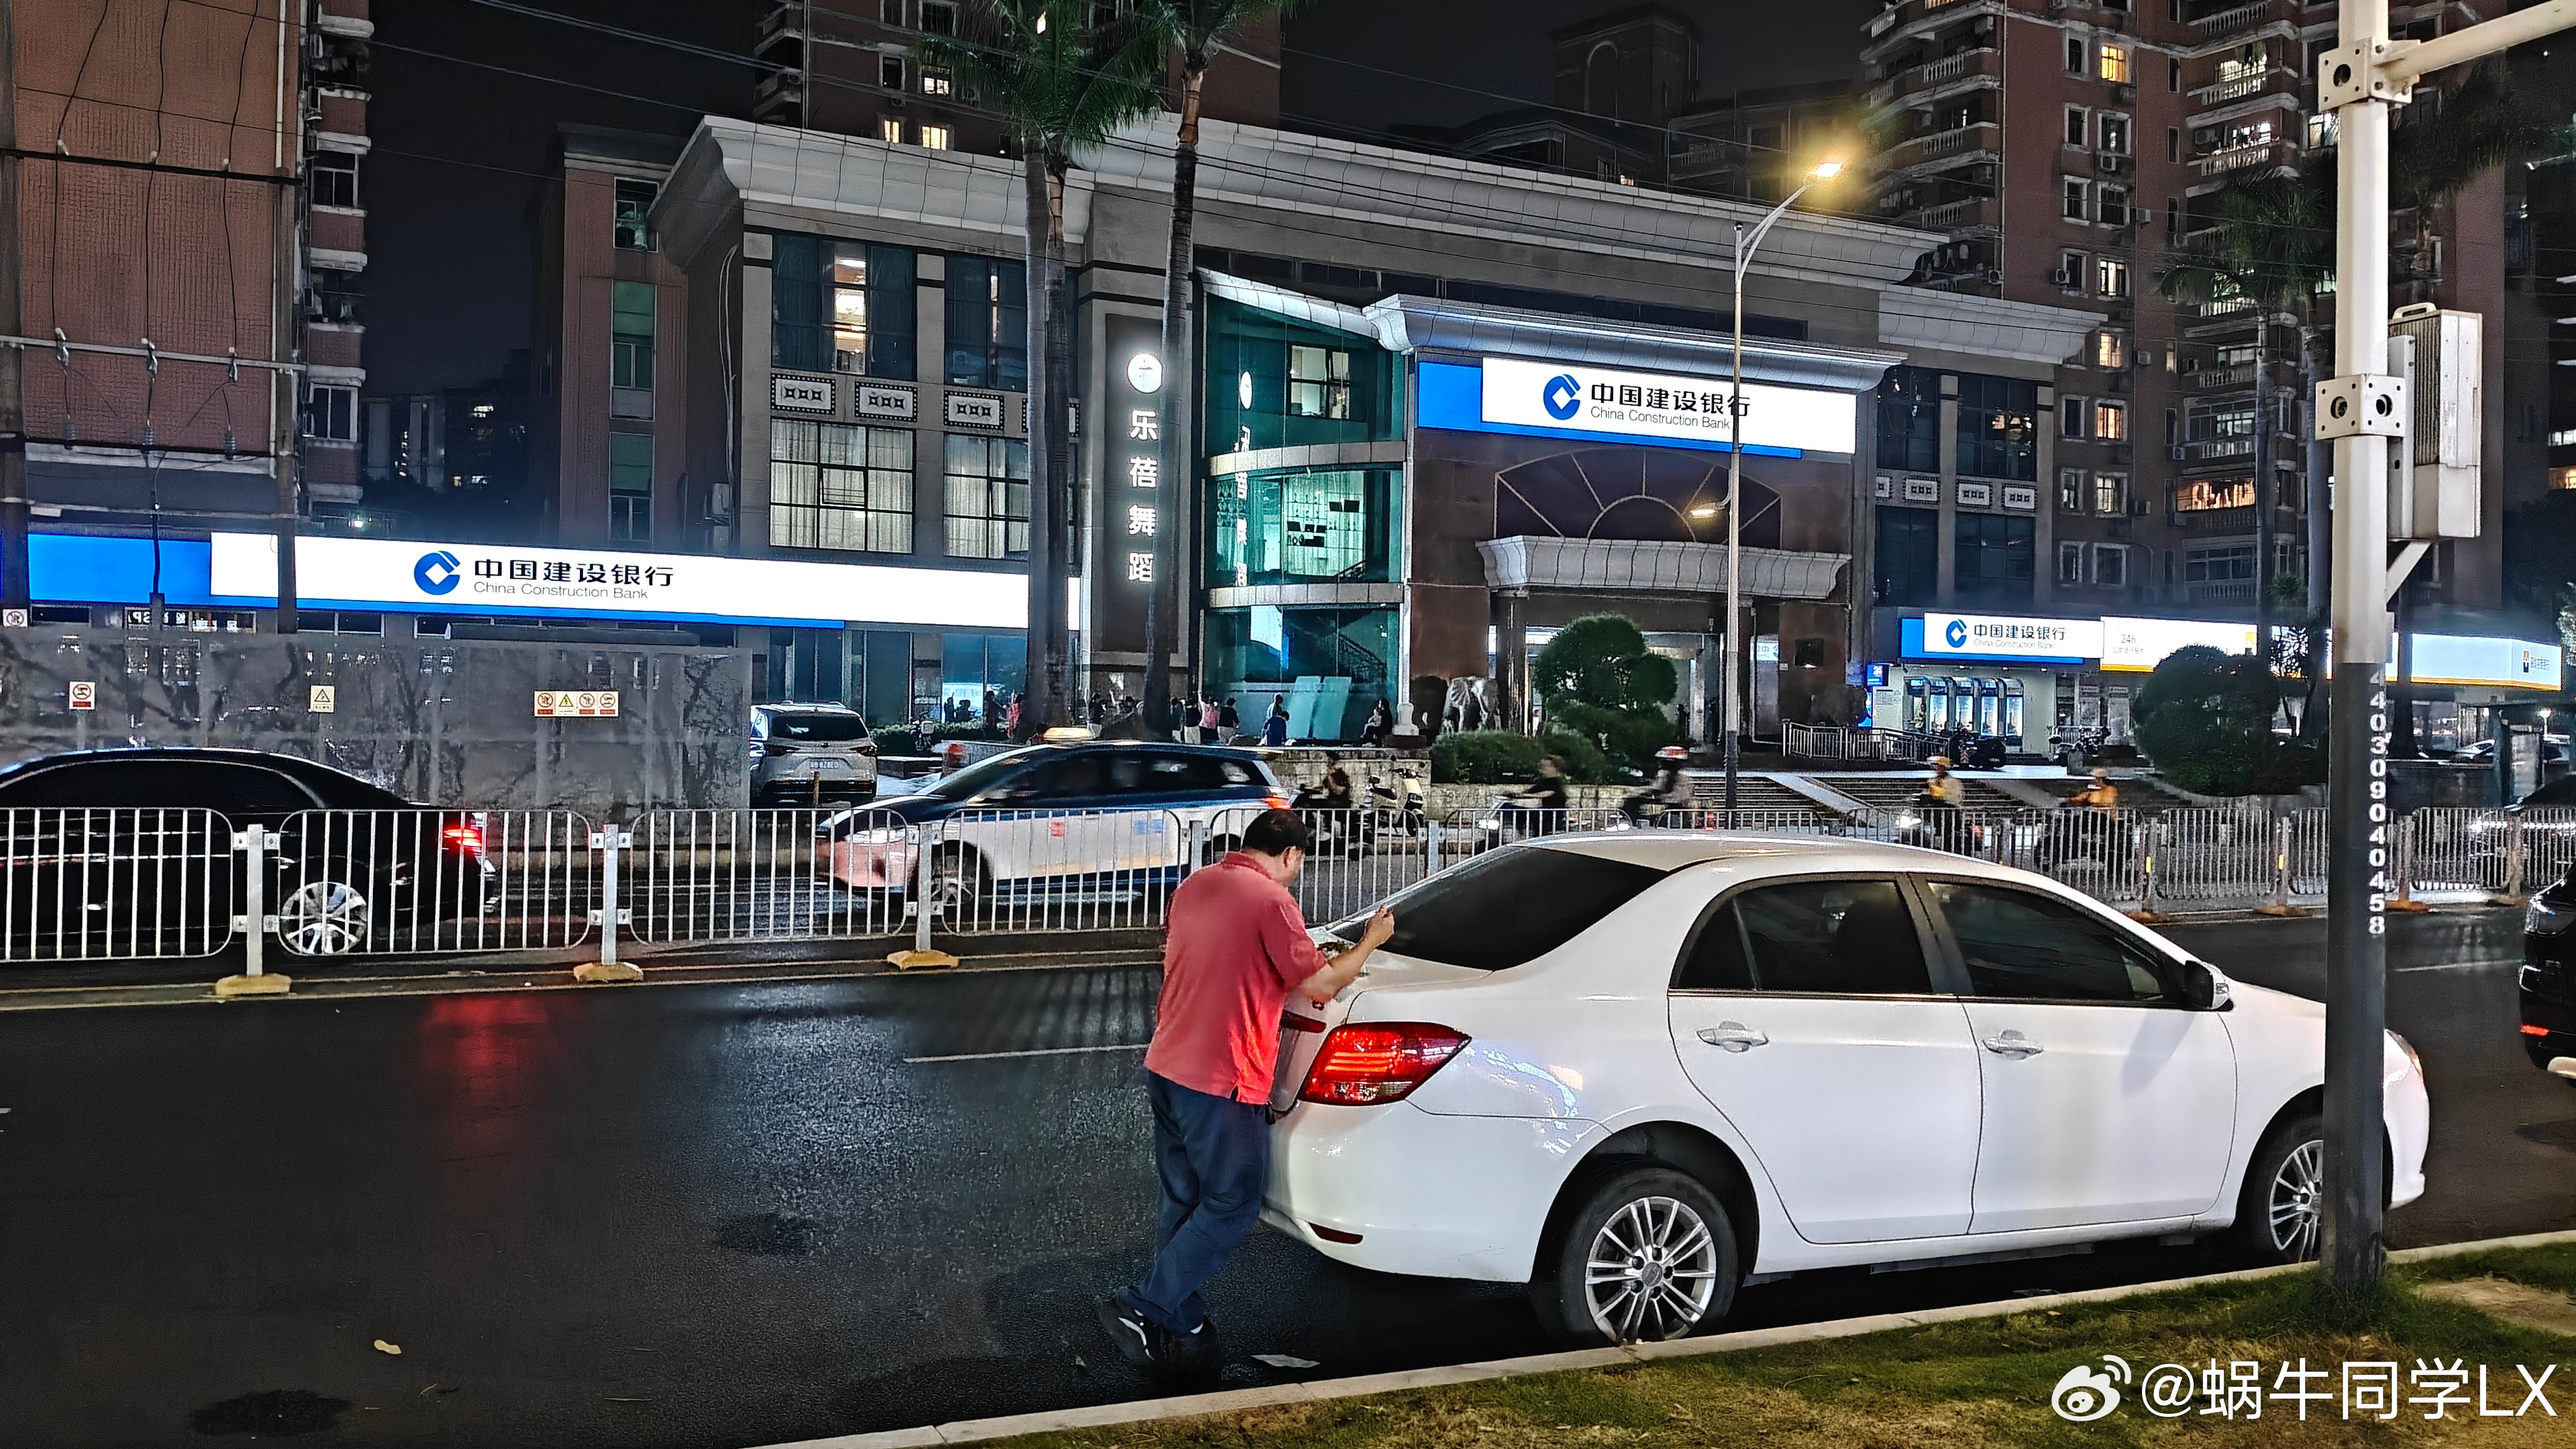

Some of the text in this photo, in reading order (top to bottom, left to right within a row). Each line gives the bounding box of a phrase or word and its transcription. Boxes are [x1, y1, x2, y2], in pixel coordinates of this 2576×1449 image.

[1591, 383, 1750, 416] 中国建设银行
[1591, 406, 1731, 430] China Construction Bank
[1128, 409, 1158, 582] 乐蓓舞蹈
[474, 559, 674, 587] 中国建设银行
[474, 582, 648, 599] China Construction Bank
[1974, 624, 2066, 640] 中国建设银行
[2121, 633, 2136, 644] 24h
[1974, 638, 1993, 647] China
